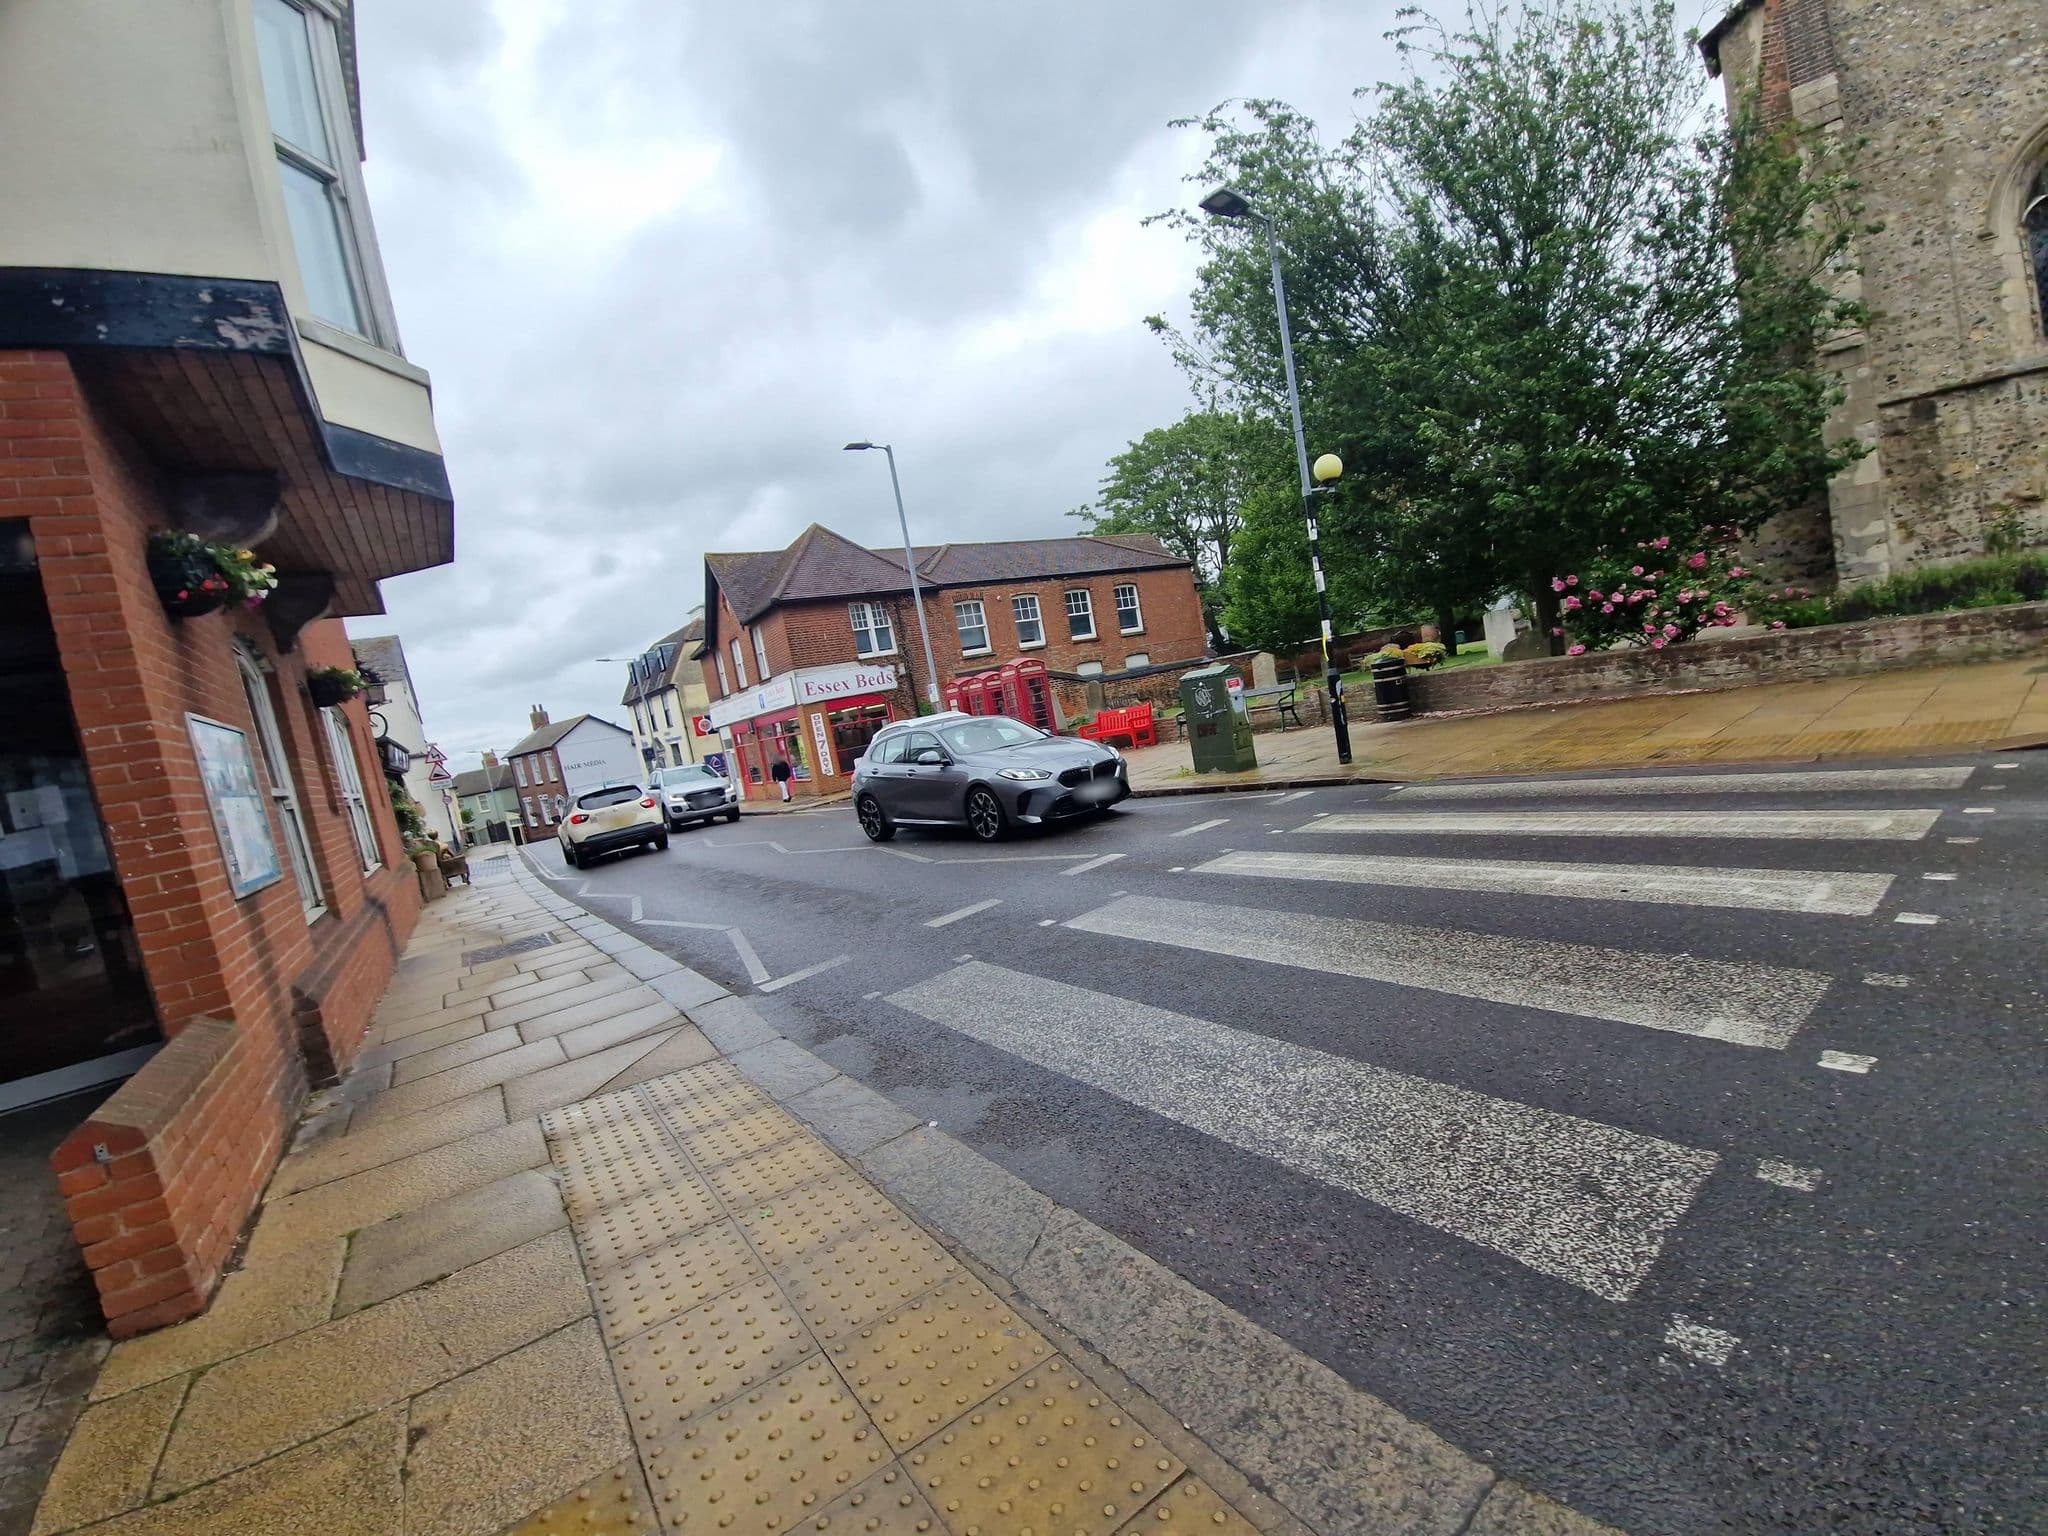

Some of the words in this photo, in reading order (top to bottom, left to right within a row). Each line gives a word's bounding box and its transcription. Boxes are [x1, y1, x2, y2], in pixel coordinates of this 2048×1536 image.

[805, 680, 850, 696] Essex
[855, 671, 893, 688] Beds
[818, 740, 826, 749] 7
